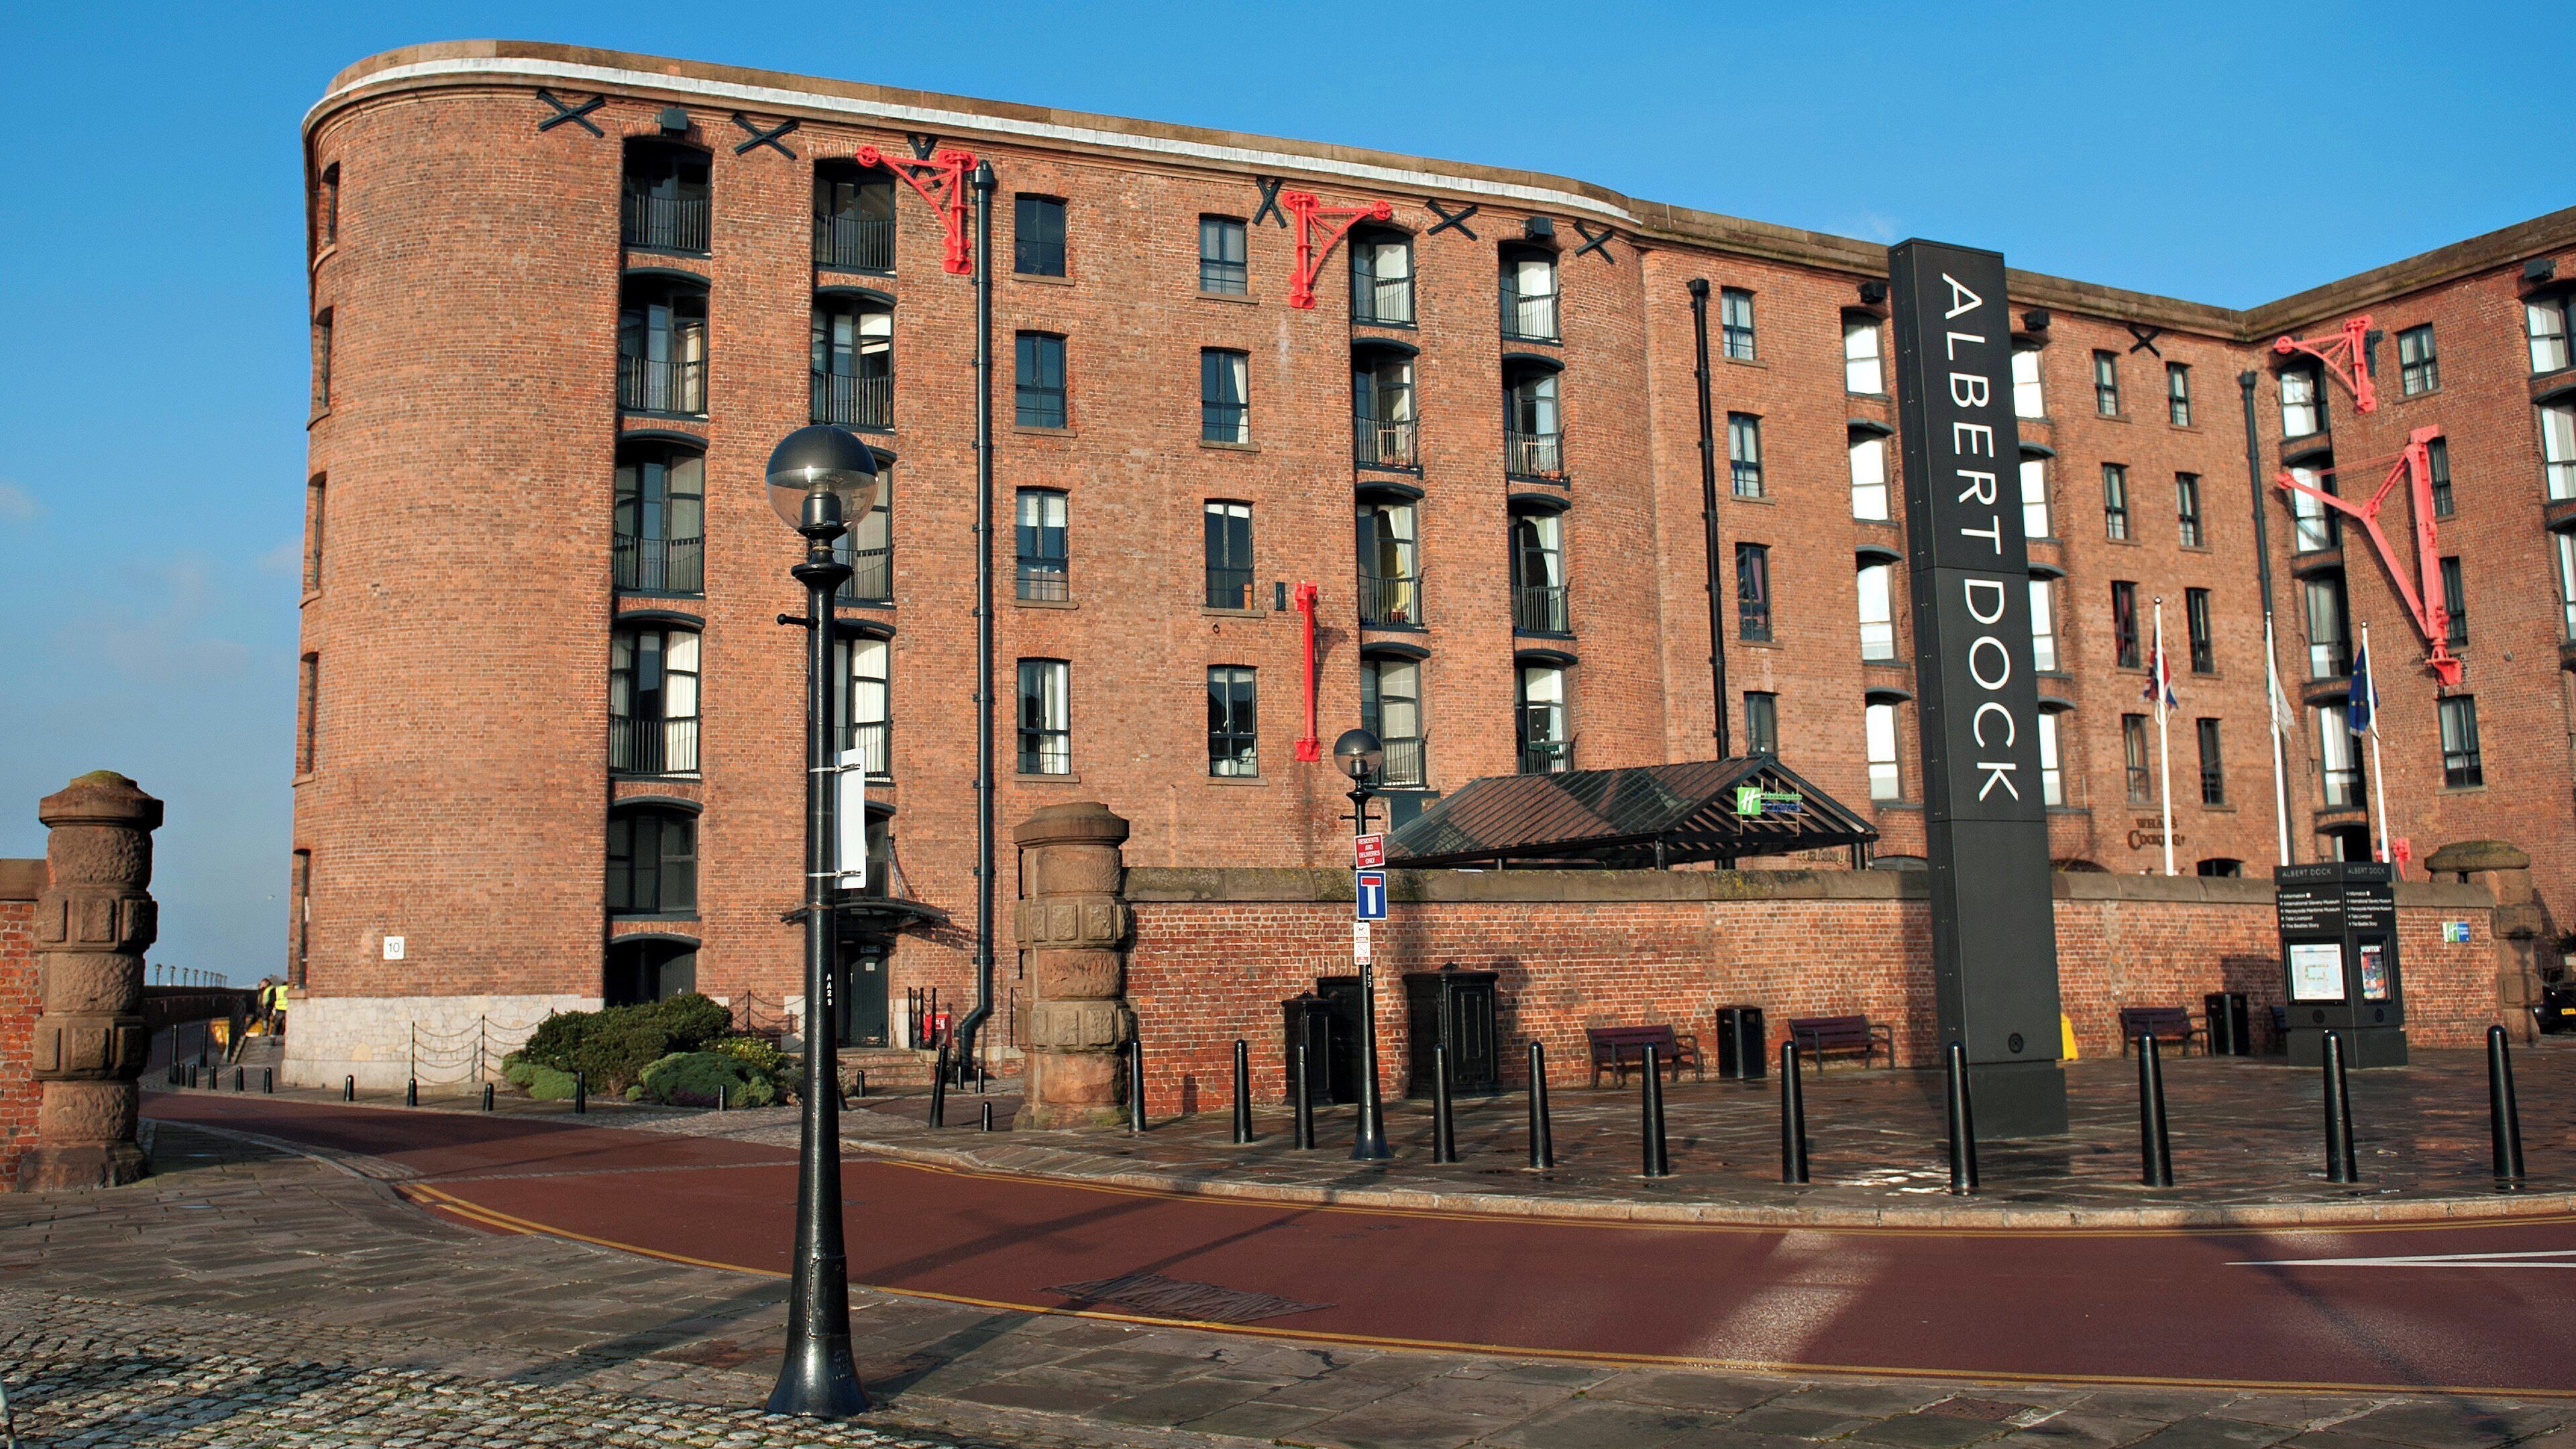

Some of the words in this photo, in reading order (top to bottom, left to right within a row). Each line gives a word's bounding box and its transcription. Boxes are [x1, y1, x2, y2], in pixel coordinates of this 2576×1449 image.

[1942, 273, 2001, 555] ALBERT
[1964, 578, 2019, 802] DOCK
[1358, 837, 1379, 845] RESIDENTS
[1358, 850, 1381, 859] DELIVERIES
[2282, 869, 2308, 877] ALBERT
[2310, 867, 2332, 876] DOCK
[2347, 867, 2368, 875] ALBERT
[2369, 867, 2384, 875] DOCK
[388, 942, 400, 953] 10
